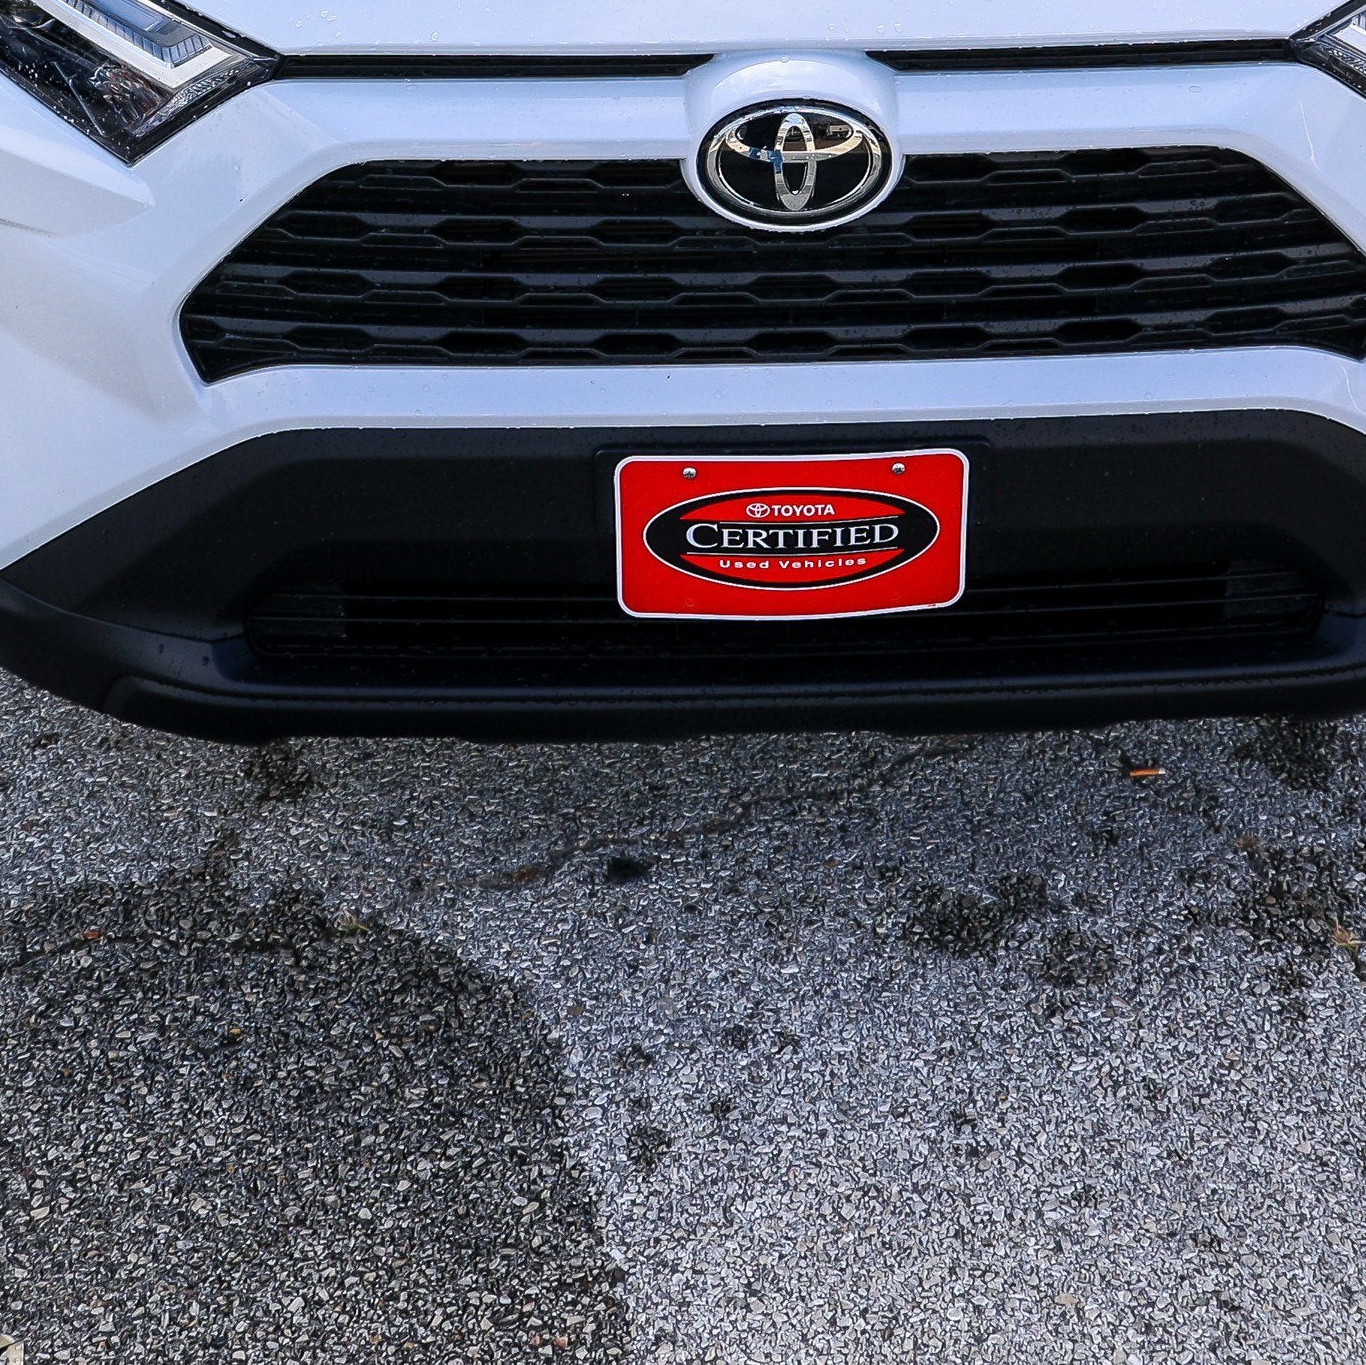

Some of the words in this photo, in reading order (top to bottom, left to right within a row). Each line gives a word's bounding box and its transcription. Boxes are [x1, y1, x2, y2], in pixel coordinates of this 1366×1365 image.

[771, 504, 835, 517] TOYOTA
[686, 523, 899, 549] CERTIFIED
[719, 559, 770, 569] Used
[779, 557, 867, 569] Vehicles
